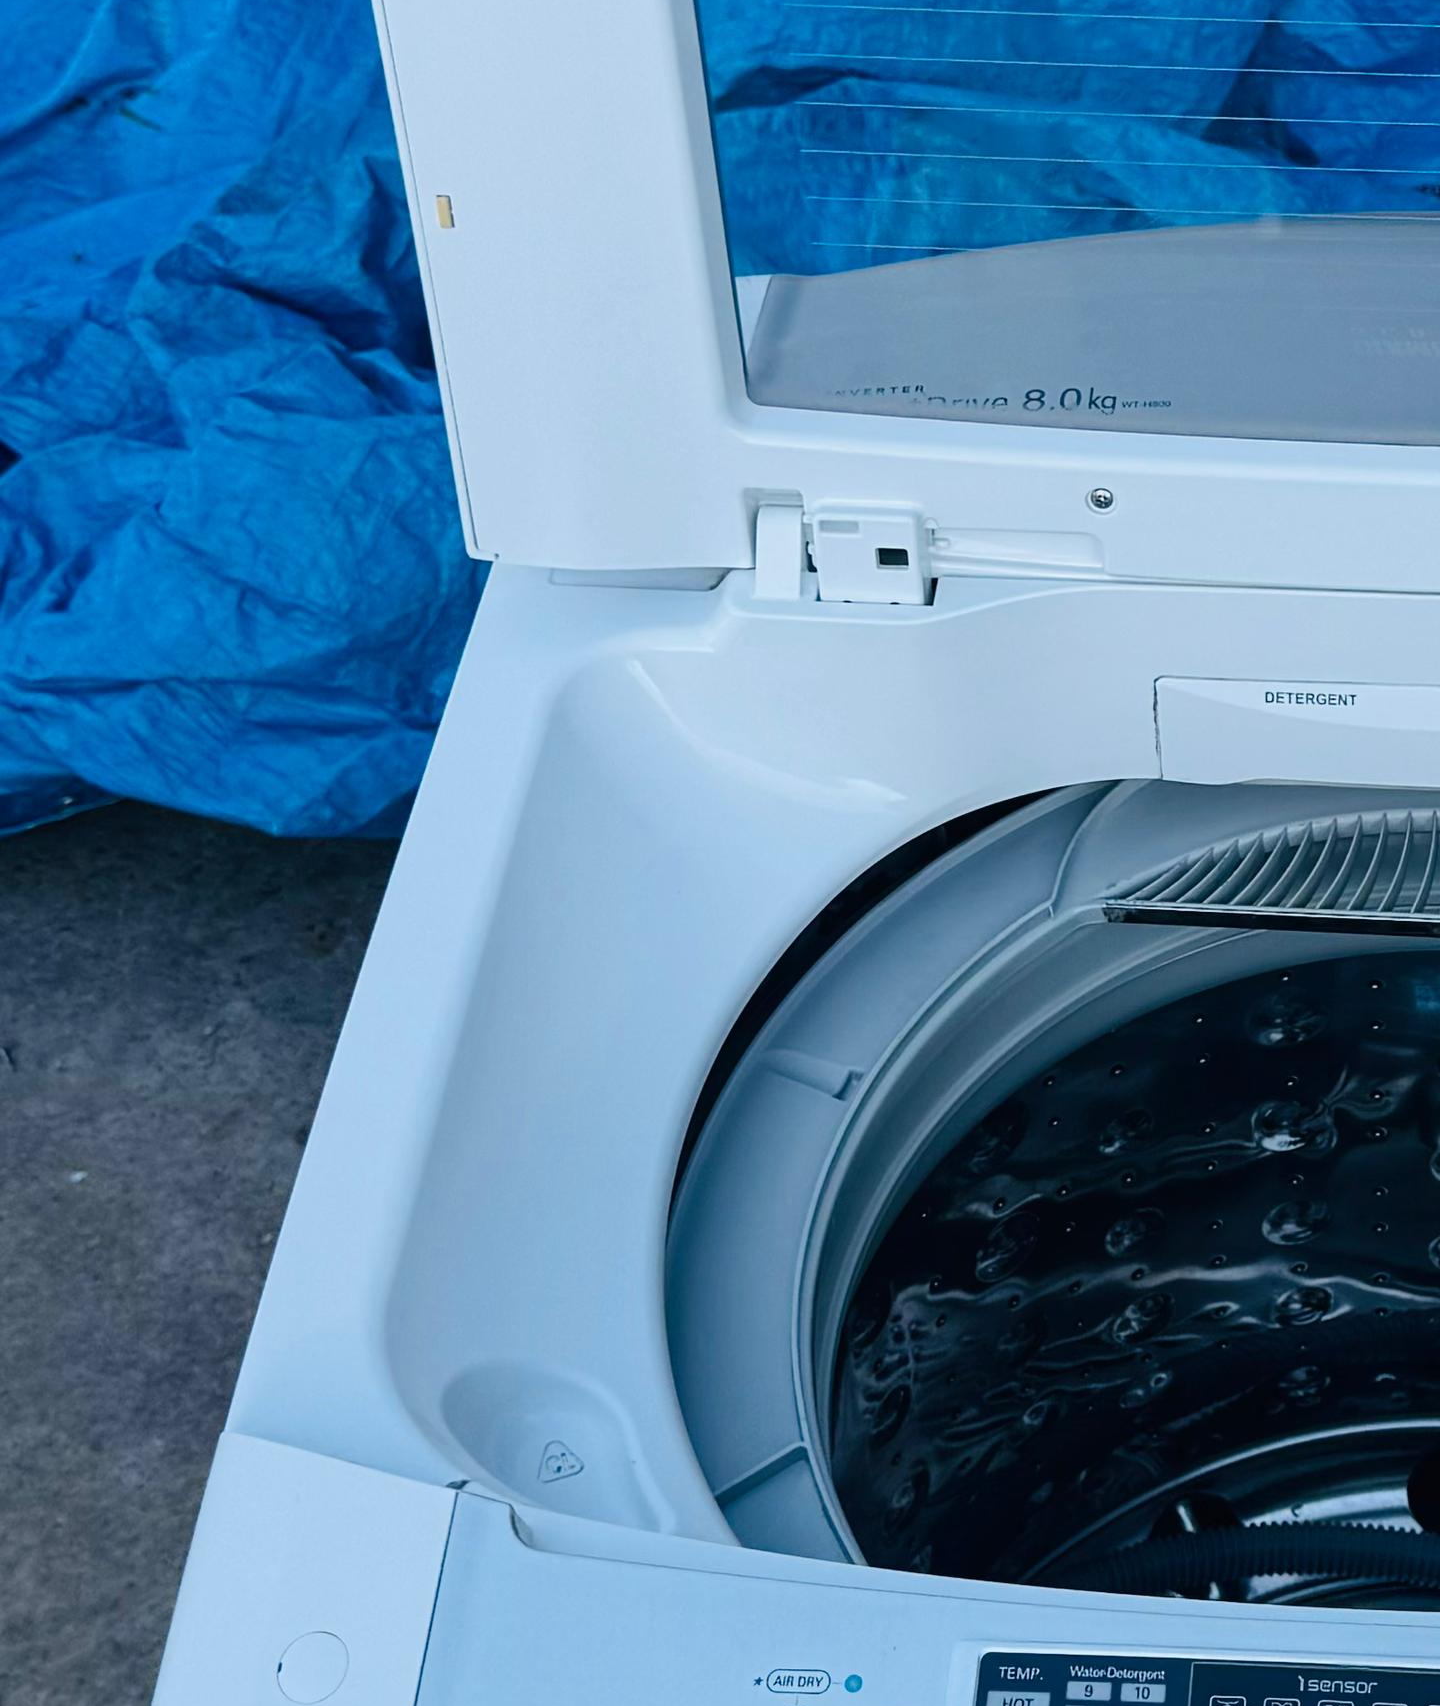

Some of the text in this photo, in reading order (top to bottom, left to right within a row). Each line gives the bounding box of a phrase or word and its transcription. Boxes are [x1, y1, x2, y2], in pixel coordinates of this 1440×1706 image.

[1264, 691, 1357, 707] DETERGENT
[999, 1666, 1044, 1681] TEMP.
[773, 1675, 824, 1688] AIR DRY
[1083, 1684, 1094, 1698] 9
[1134, 1686, 1150, 1700] 10
